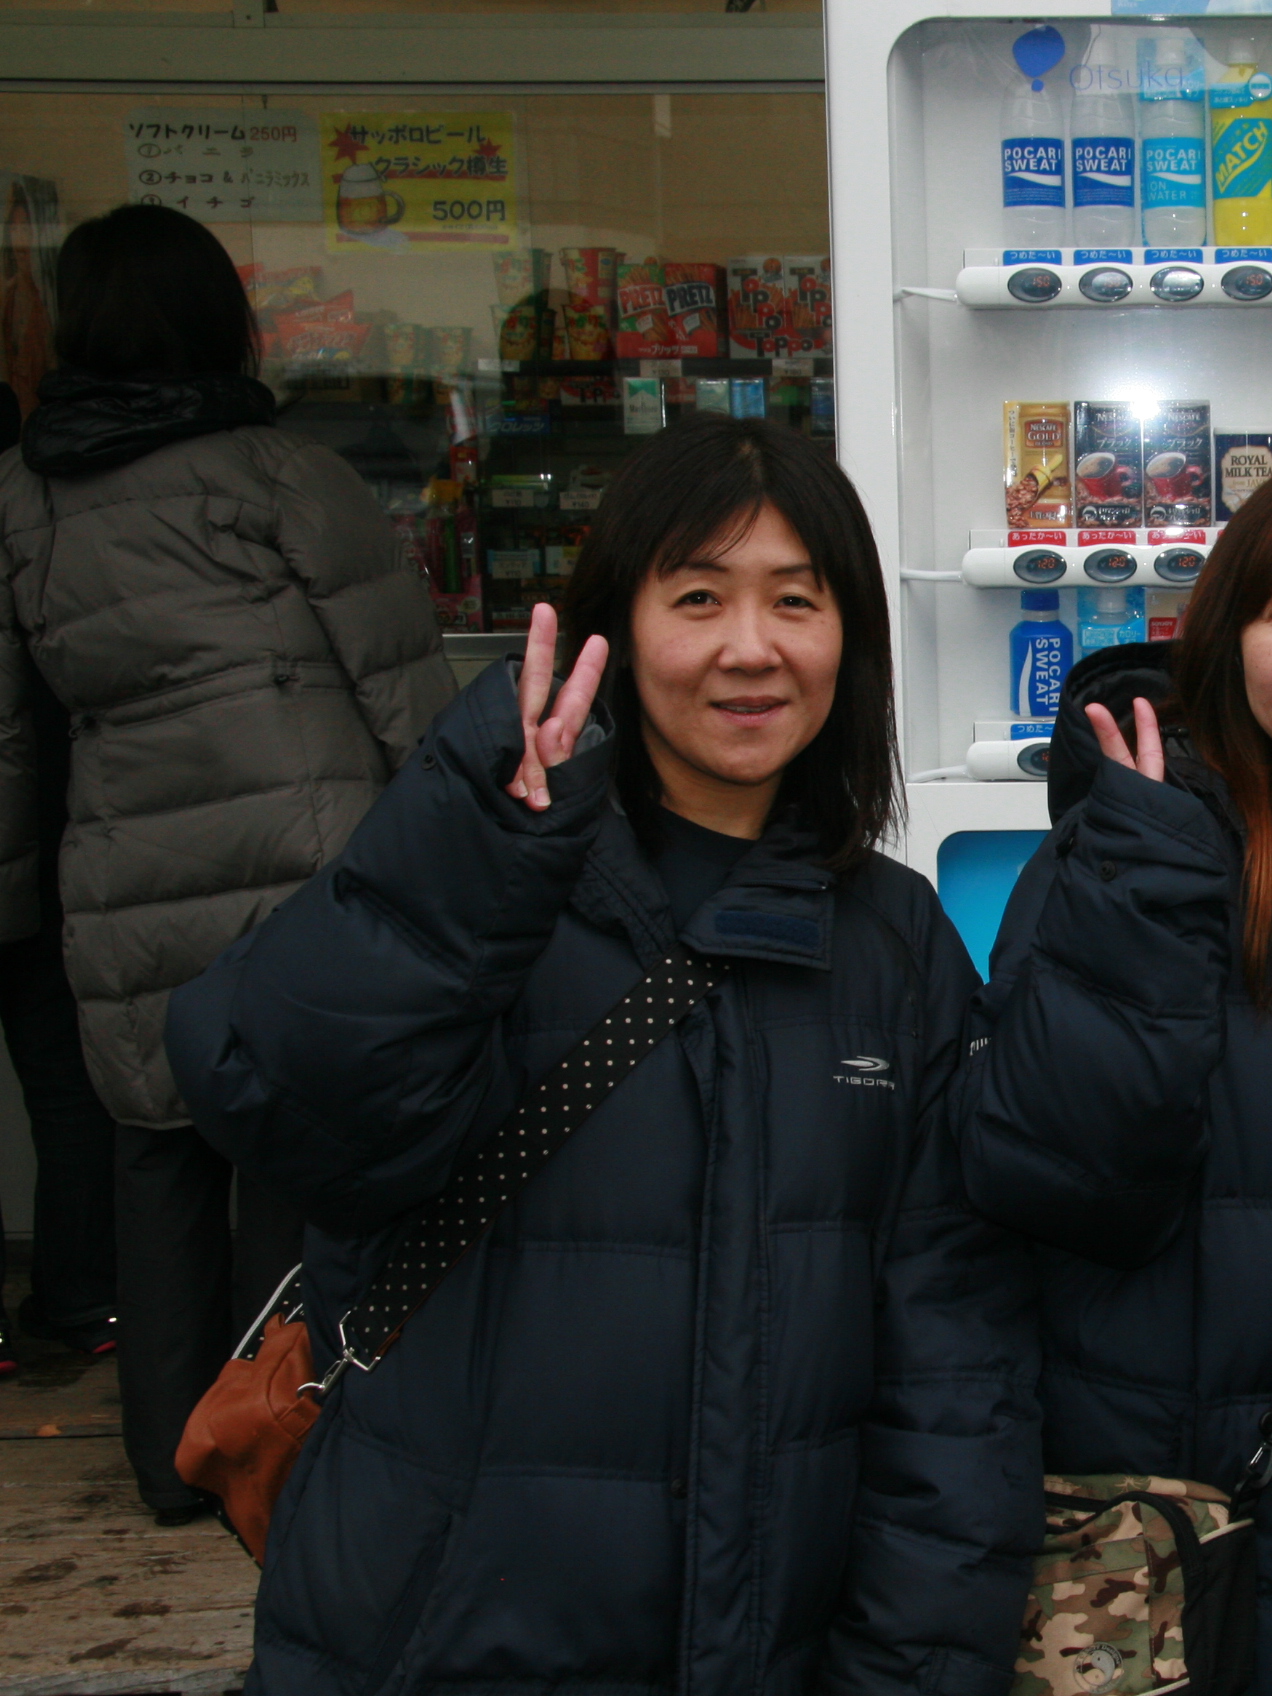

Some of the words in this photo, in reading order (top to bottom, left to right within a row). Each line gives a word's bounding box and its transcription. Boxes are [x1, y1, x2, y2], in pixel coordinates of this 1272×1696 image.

[1069, 60, 1183, 91] Otsuka
[129, 123, 246, 140] ソフトクリーム
[250, 126, 297, 142] 250円
[349, 124, 486, 143] サッポロビール
[1004, 147, 1061, 160] POCARI
[1076, 146, 1131, 160] POCARI
[1146, 149, 1201, 160] POCARI
[1216, 121, 1268, 189] MATCH
[374, 156, 509, 177] クラシック樽生
[1005, 159, 1057, 172] SWEAT
[1076, 159, 1127, 172] SWEAT
[1147, 160, 1197, 171] SWEAT
[433, 199, 506, 221] 500円
[1032, 276, 1050, 286] 150
[1246, 276, 1264, 286] 150
[619, 287, 665, 314] PRETZ
[667, 285, 713, 313] PRETZ
[1027, 432, 1061, 441] GOLD
[1097, 438, 1132, 448] ブラック
[1168, 437, 1203, 447] ブラック
[1231, 455, 1268, 465] ROYAL
[1225, 467, 1251, 477] MILK
[1254, 467, 1272, 477] TEA
[1037, 558, 1056, 568] 120
[1108, 556, 1126, 567] 120
[1178, 556, 1197, 567] 120
[1036, 638, 1048, 705] SWEAT
[1049, 638, 1061, 712] POCARI
